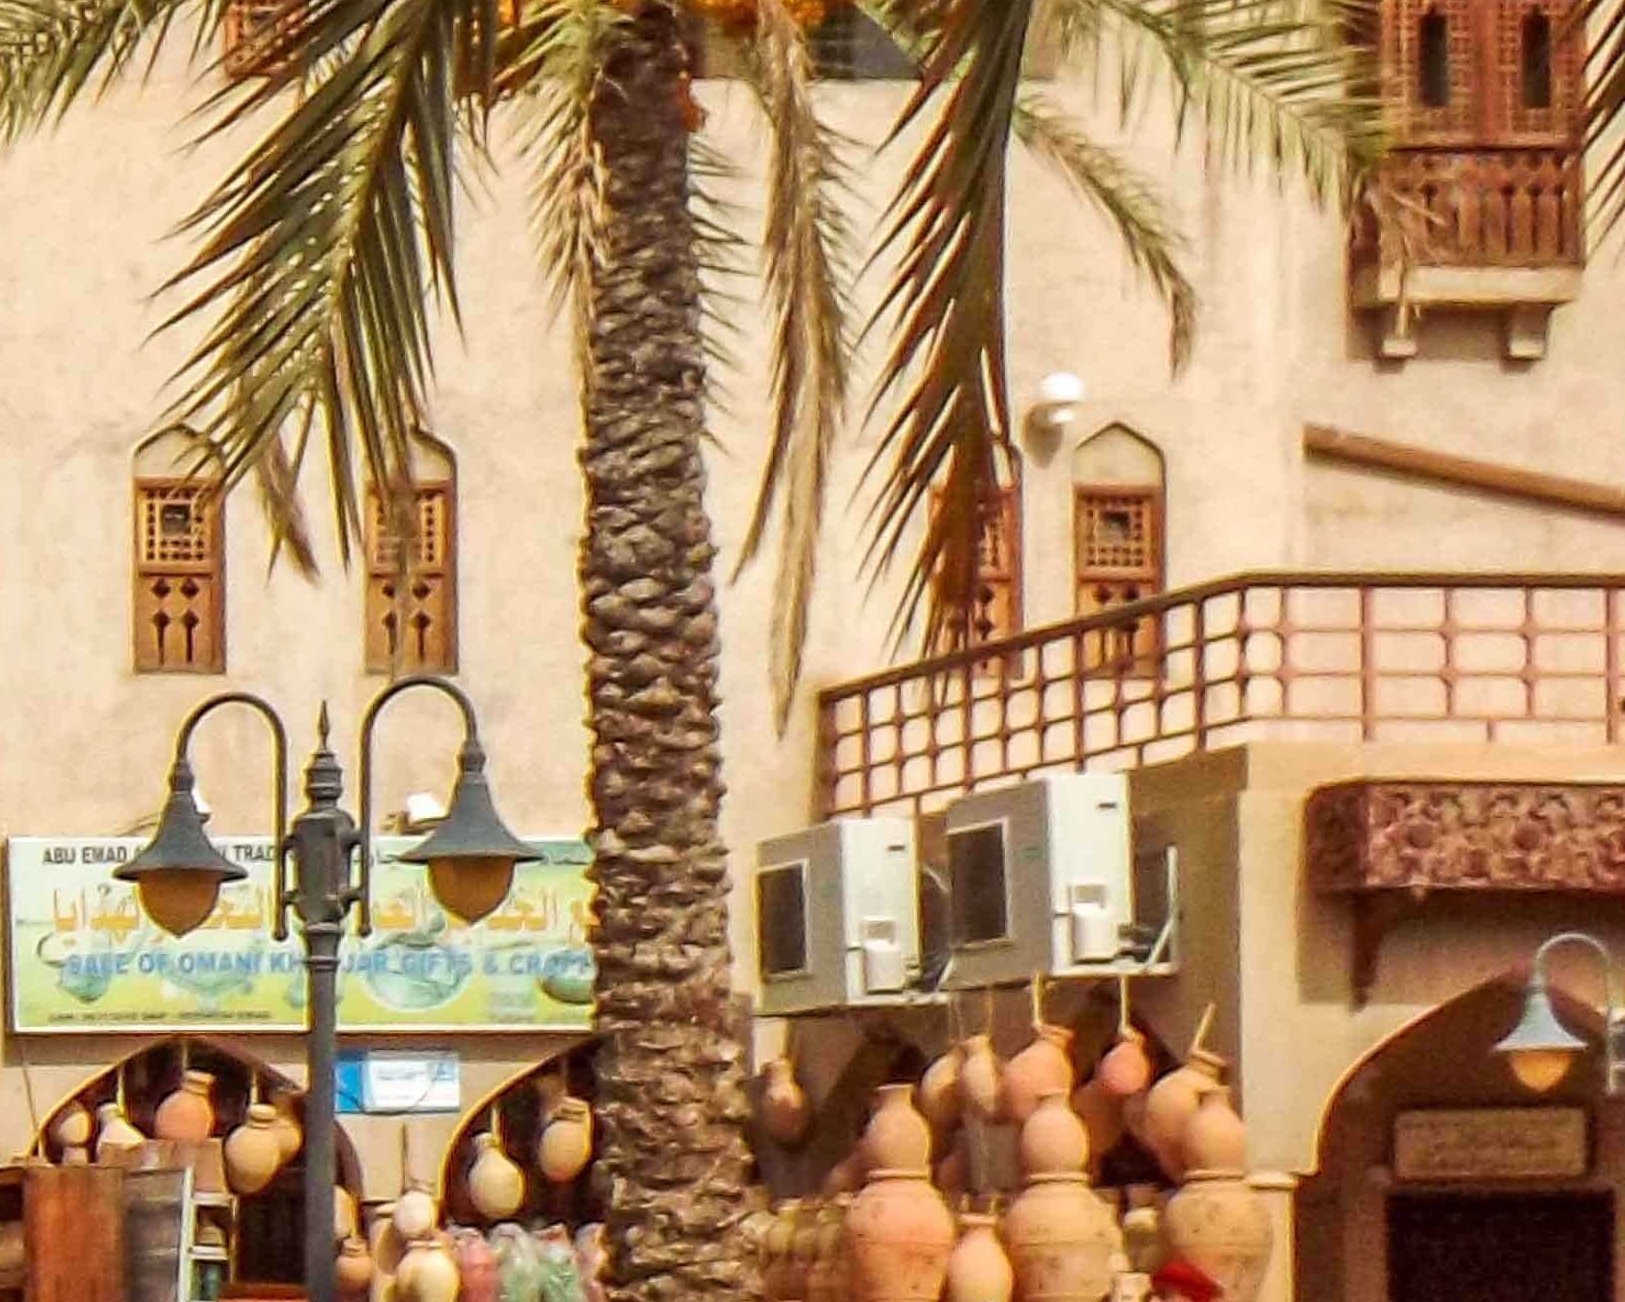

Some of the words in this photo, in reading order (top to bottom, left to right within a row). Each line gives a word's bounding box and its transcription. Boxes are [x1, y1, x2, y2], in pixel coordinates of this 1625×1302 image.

[42, 846, 76, 864] ABU
[82, 846, 127, 864] EMAD
[232, 844, 277, 862] TRAD
[66, 953, 127, 975] SALE
[138, 953, 169, 974] OF
[178, 953, 261, 973] OMANI
[270, 953, 387, 973] KHJAR
